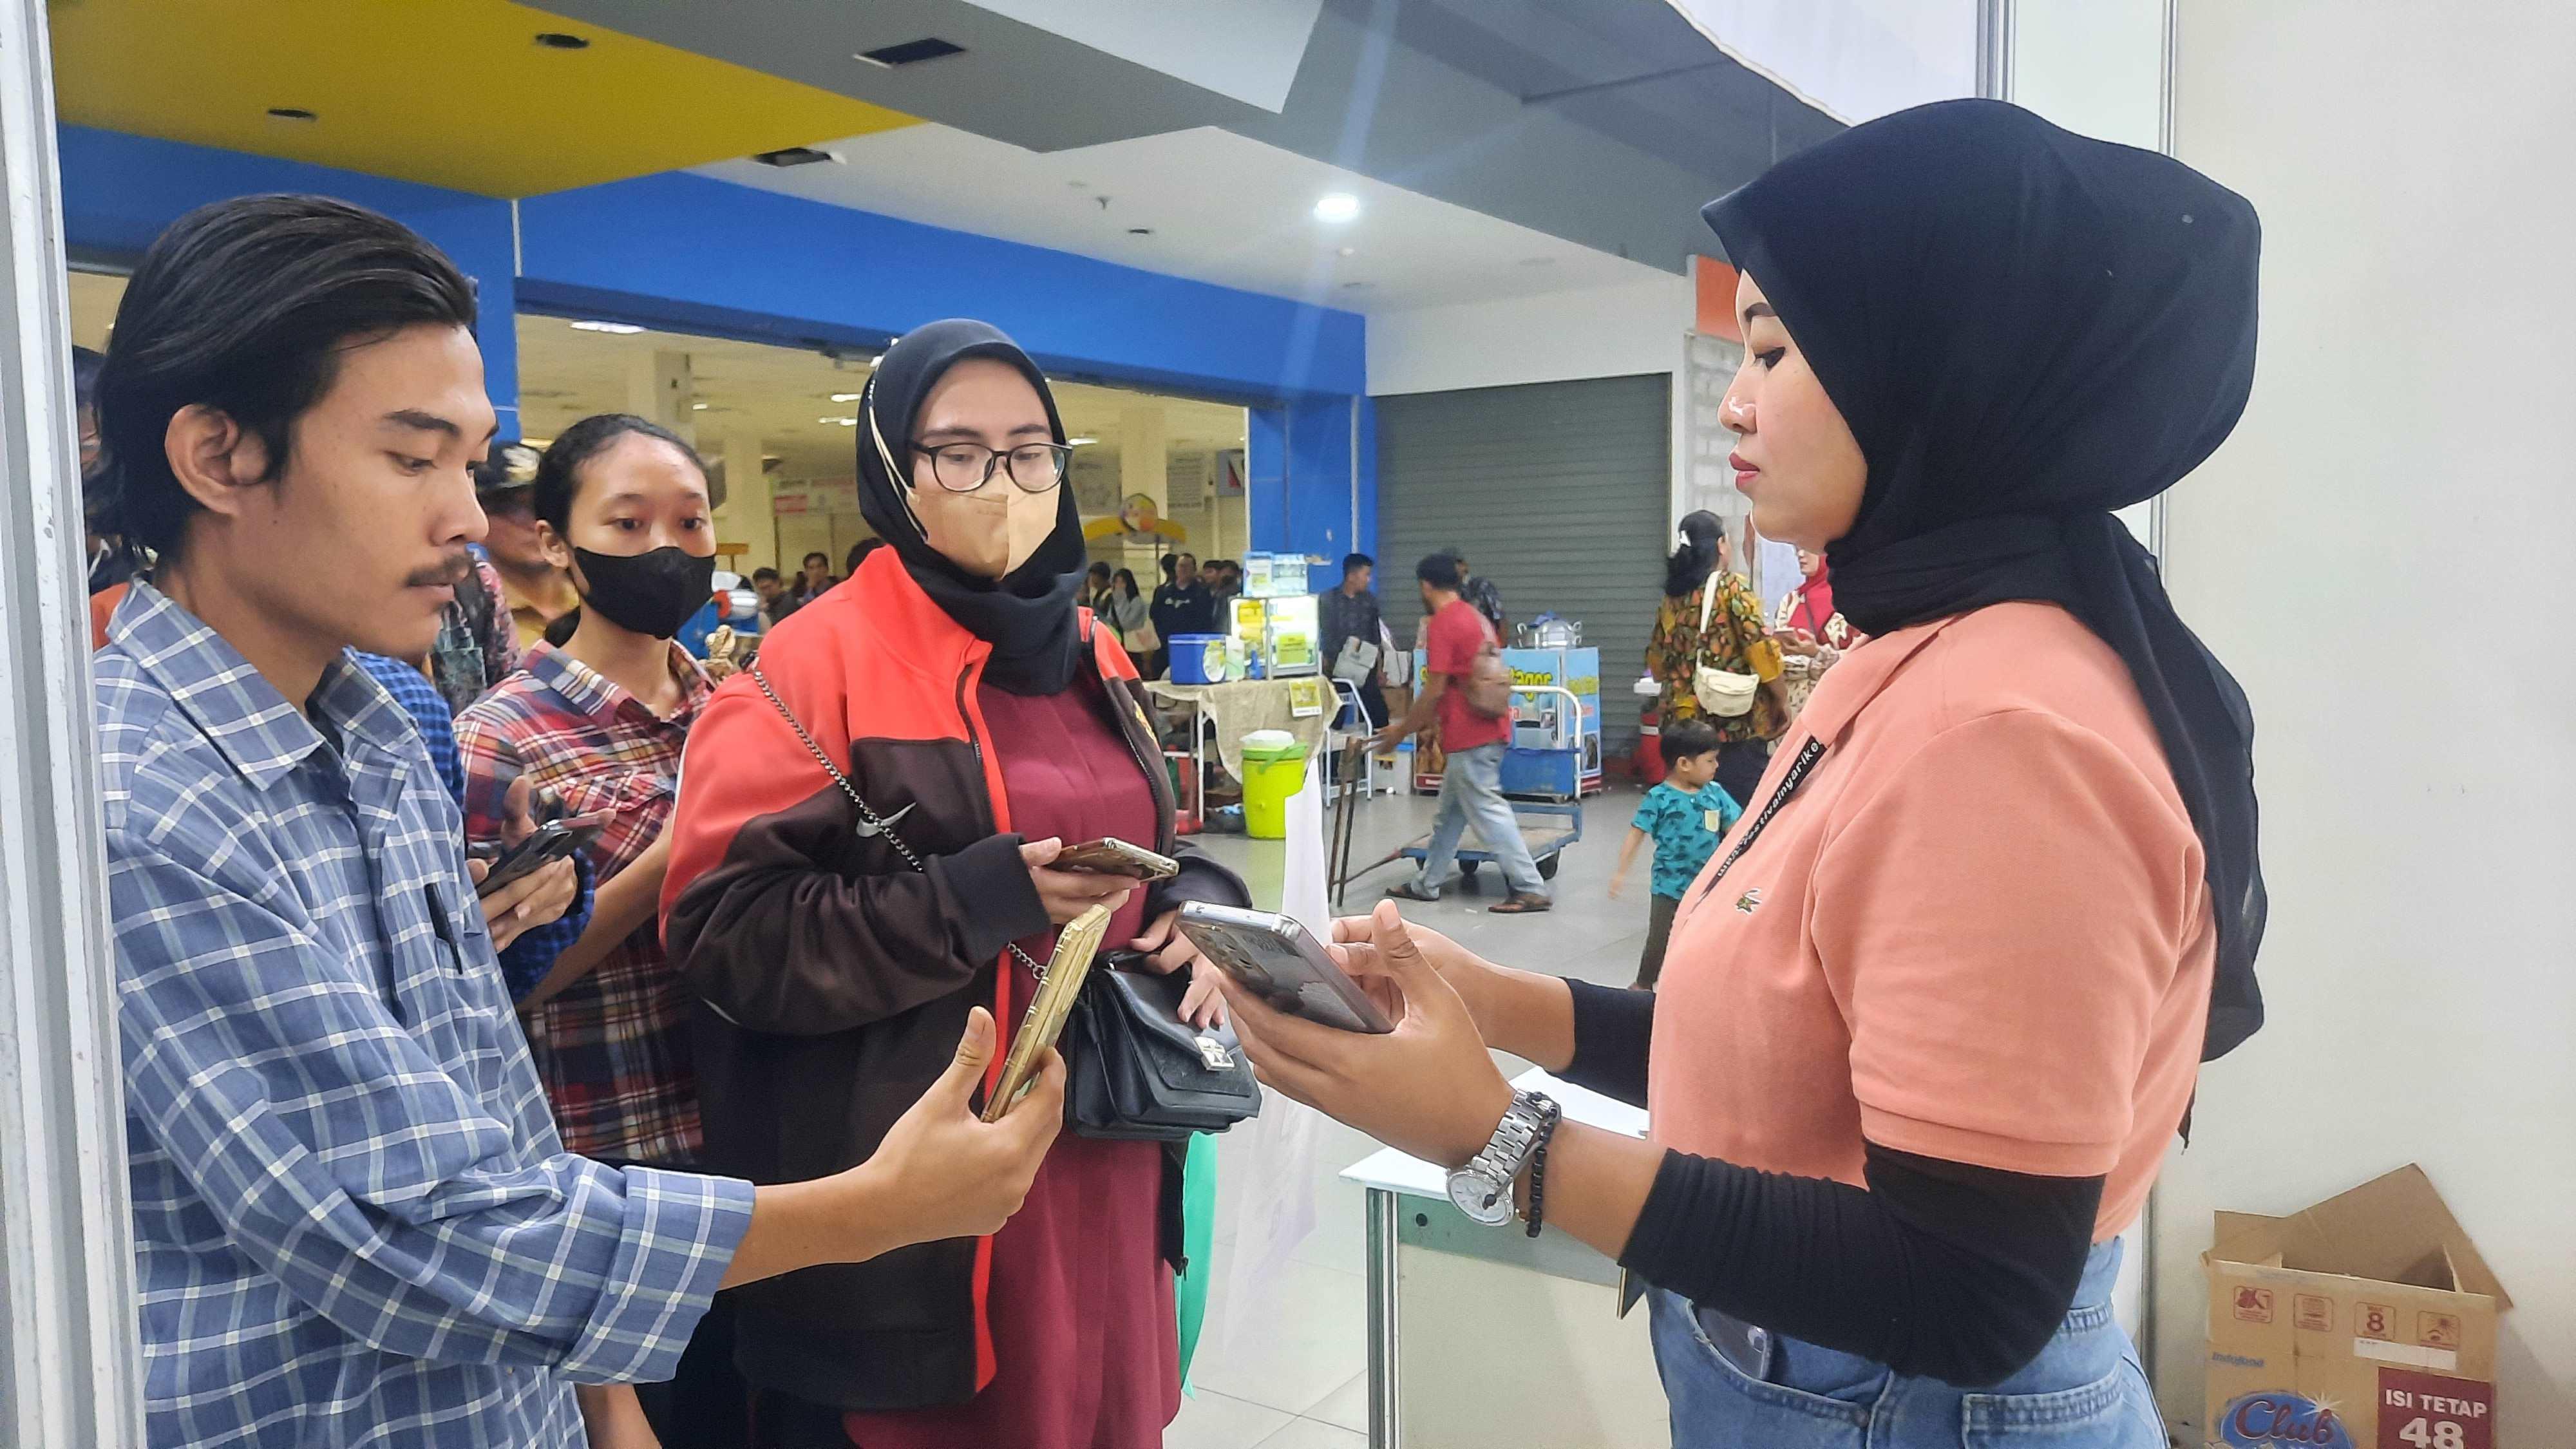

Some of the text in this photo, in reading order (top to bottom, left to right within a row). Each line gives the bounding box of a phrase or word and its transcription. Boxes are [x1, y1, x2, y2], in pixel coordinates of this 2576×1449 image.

[2367, 1312, 2385, 1331] 8
[2385, 1389, 2488, 1418] ISI TETAP
[2235, 1399, 2334, 1446] Club
[2399, 1417, 2465, 1449] 48
